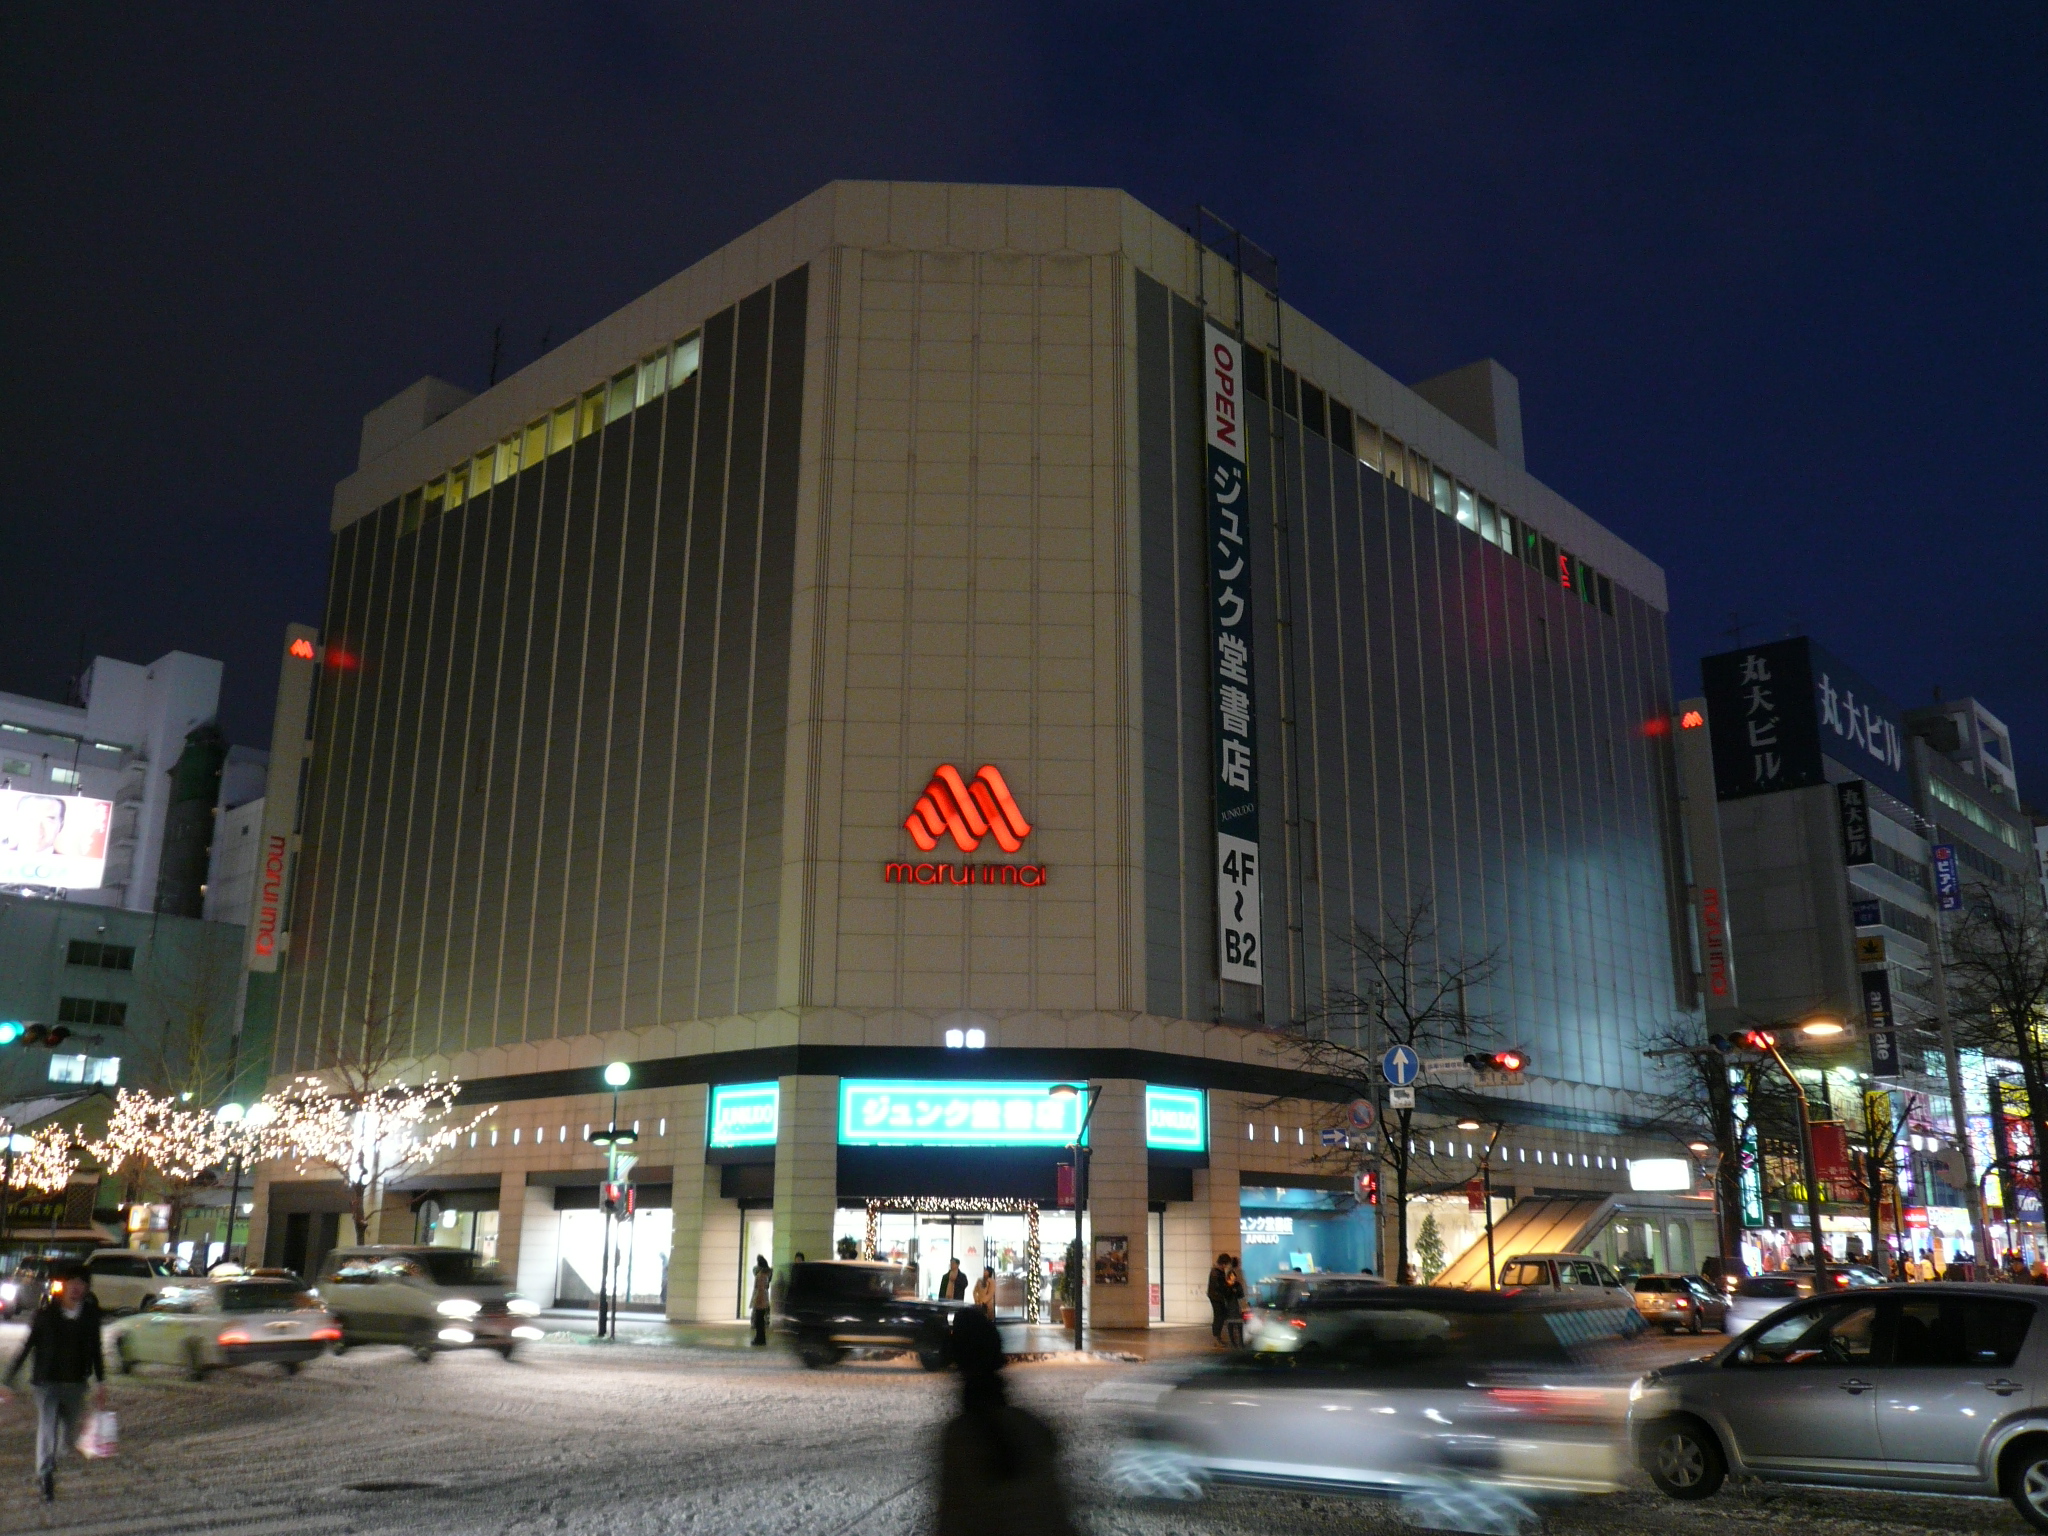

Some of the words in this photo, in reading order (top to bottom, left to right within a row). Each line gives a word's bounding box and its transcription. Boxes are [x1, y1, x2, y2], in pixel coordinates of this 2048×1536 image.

[1214, 345, 1237, 446] OPEN
[1213, 465, 1250, 792] ジュンク堂書店
[1740, 654, 1781, 781] 丸大ビル
[1818, 672, 1901, 772] 丸大ビル
[1221, 803, 1255, 823] JUNKUDO
[1842, 789, 1867, 856] 丸大ビル
[263, 836, 286, 903] marui
[885, 863, 975, 885] marui
[983, 864, 1046, 886] imai
[1222, 849, 1255, 887] 4F
[256, 907, 277, 956] imai
[1224, 928, 1256, 969] B2
[1703, 889, 1720, 949] marui
[1708, 952, 1727, 996] imai
[1869, 990, 1890, 1062] animate
[862, 1096, 1065, 1130] ジュンク堂書店
